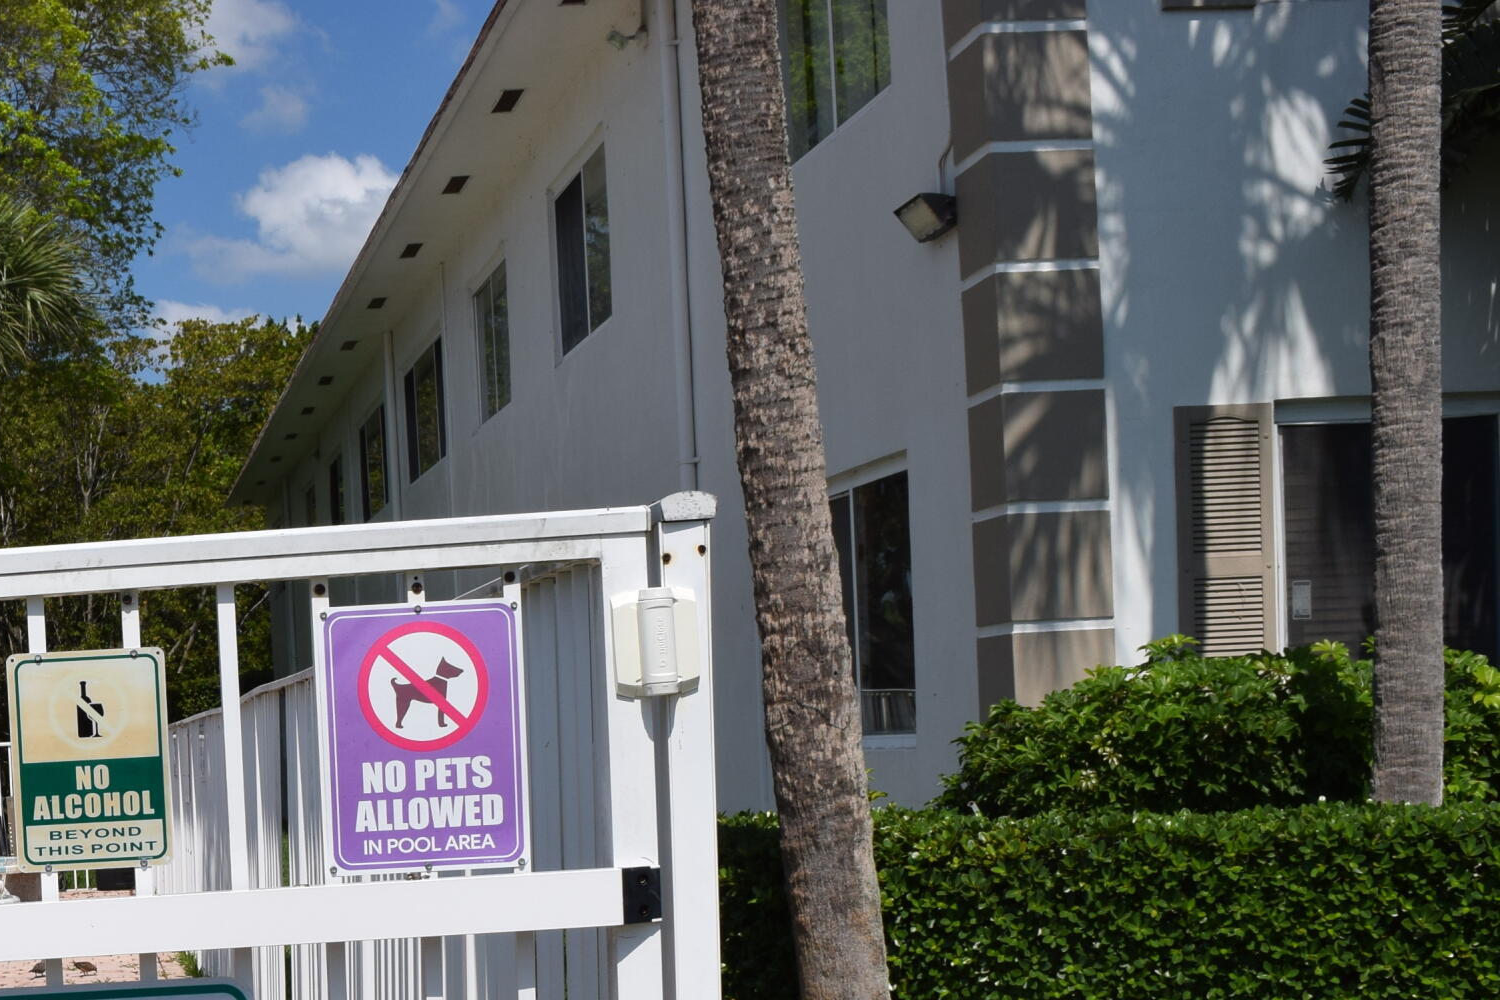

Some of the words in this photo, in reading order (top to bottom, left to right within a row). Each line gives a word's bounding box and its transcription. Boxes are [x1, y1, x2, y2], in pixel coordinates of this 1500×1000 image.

[76, 765, 109, 790] NO
[363, 760, 406, 793] NO
[415, 756, 492, 790] PETS
[34, 791, 154, 820] ALCOHOL
[356, 794, 503, 832] ALLOWED
[50, 827, 141, 840] BEYOND
[364, 840, 382, 855] IN
[388, 837, 441, 853] POOL
[445, 834, 495, 850] AREA
[35, 845, 83, 856] THIS
[92, 841, 156, 853] POINT
